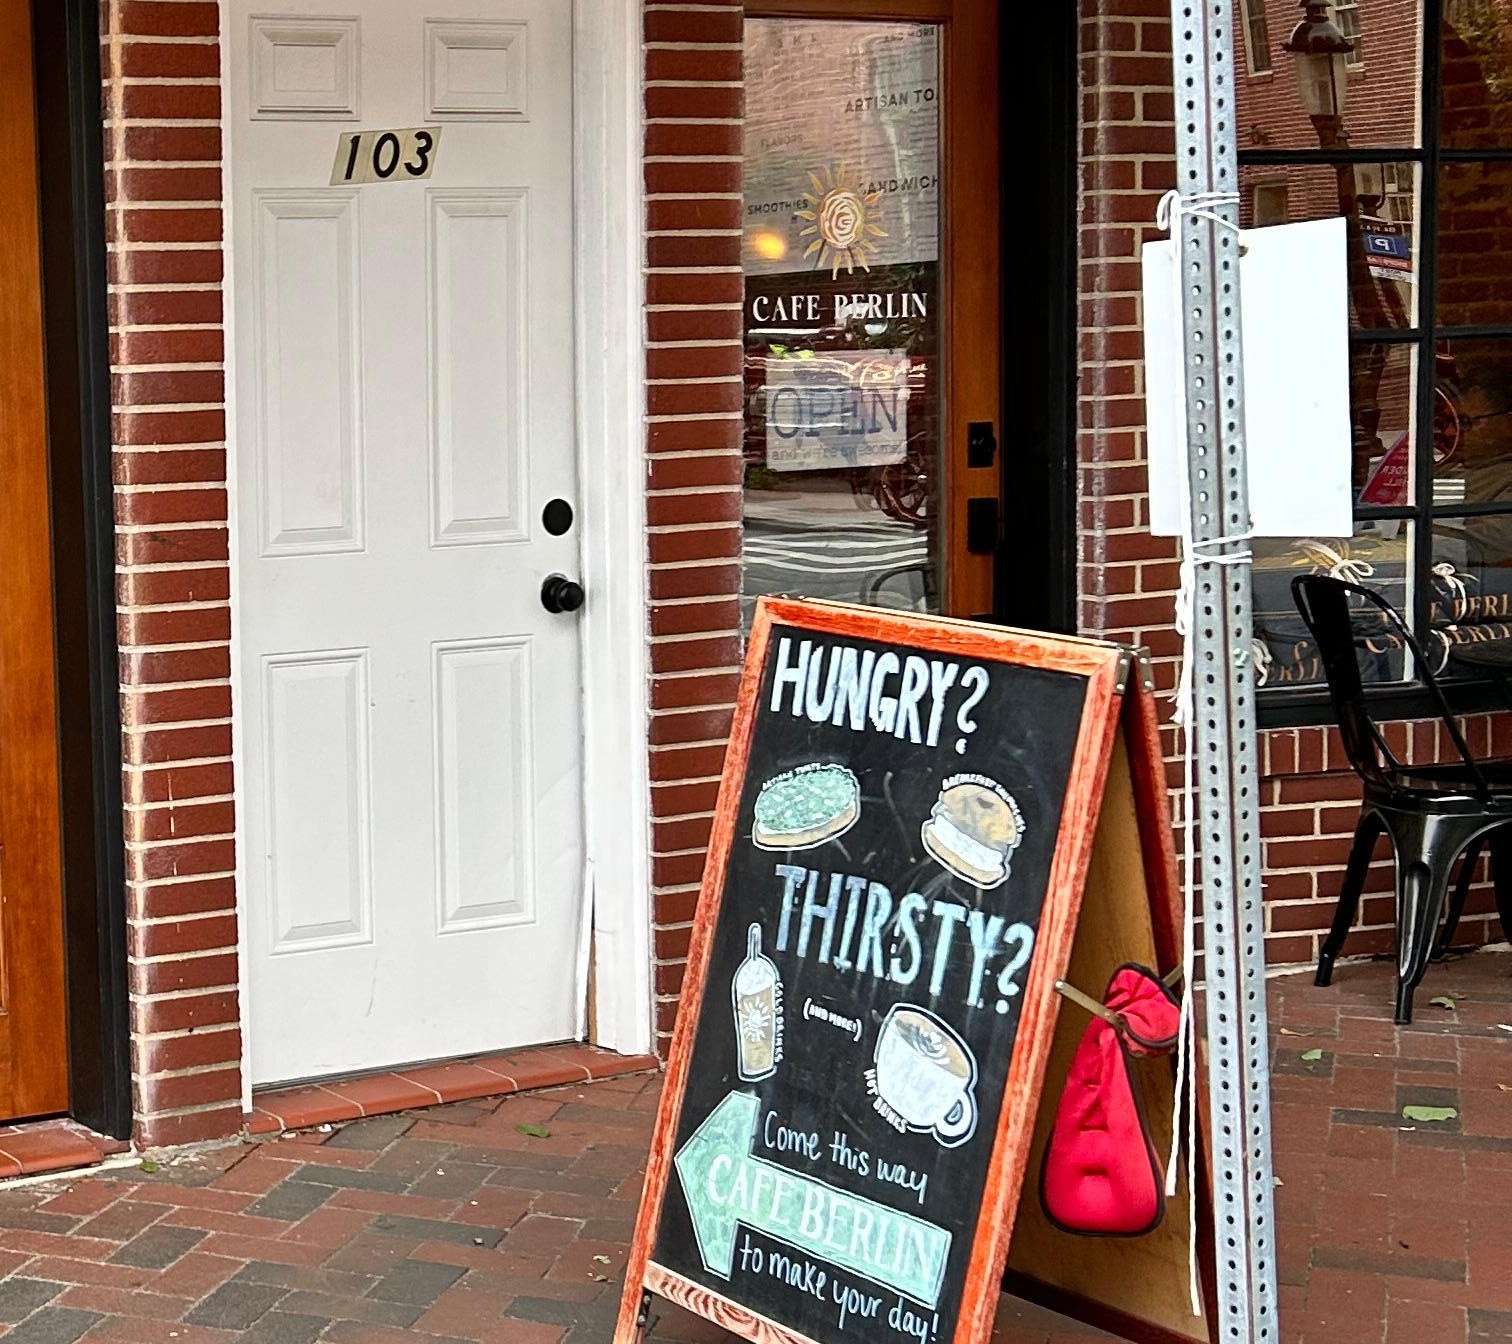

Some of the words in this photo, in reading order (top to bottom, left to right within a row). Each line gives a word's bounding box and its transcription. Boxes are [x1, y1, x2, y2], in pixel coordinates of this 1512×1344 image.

[844, 92, 908, 114] ARTISAN
[344, 131, 433, 180] 103
[748, 199, 809, 215] SMOOTHIES
[752, 295, 820, 322] CAFE
[834, 292, 928, 320] BERLIN
[771, 386, 898, 439] OPEN
[770, 637, 990, 755] HUNGRY?
[775, 864, 1035, 1015] THIRSTY?
[863, 1068, 879, 1096] HOT
[872, 1096, 908, 1134] DRINKS
[764, 1110, 822, 1161] Come
[829, 1131, 870, 1176] this
[876, 1158, 928, 1205] way
[708, 1155, 795, 1224] CAFE
[798, 1183, 938, 1281] BERLIN
[739, 1235, 763, 1274] to
[769, 1252, 826, 1301] make
[833, 1280, 883, 1330] your
